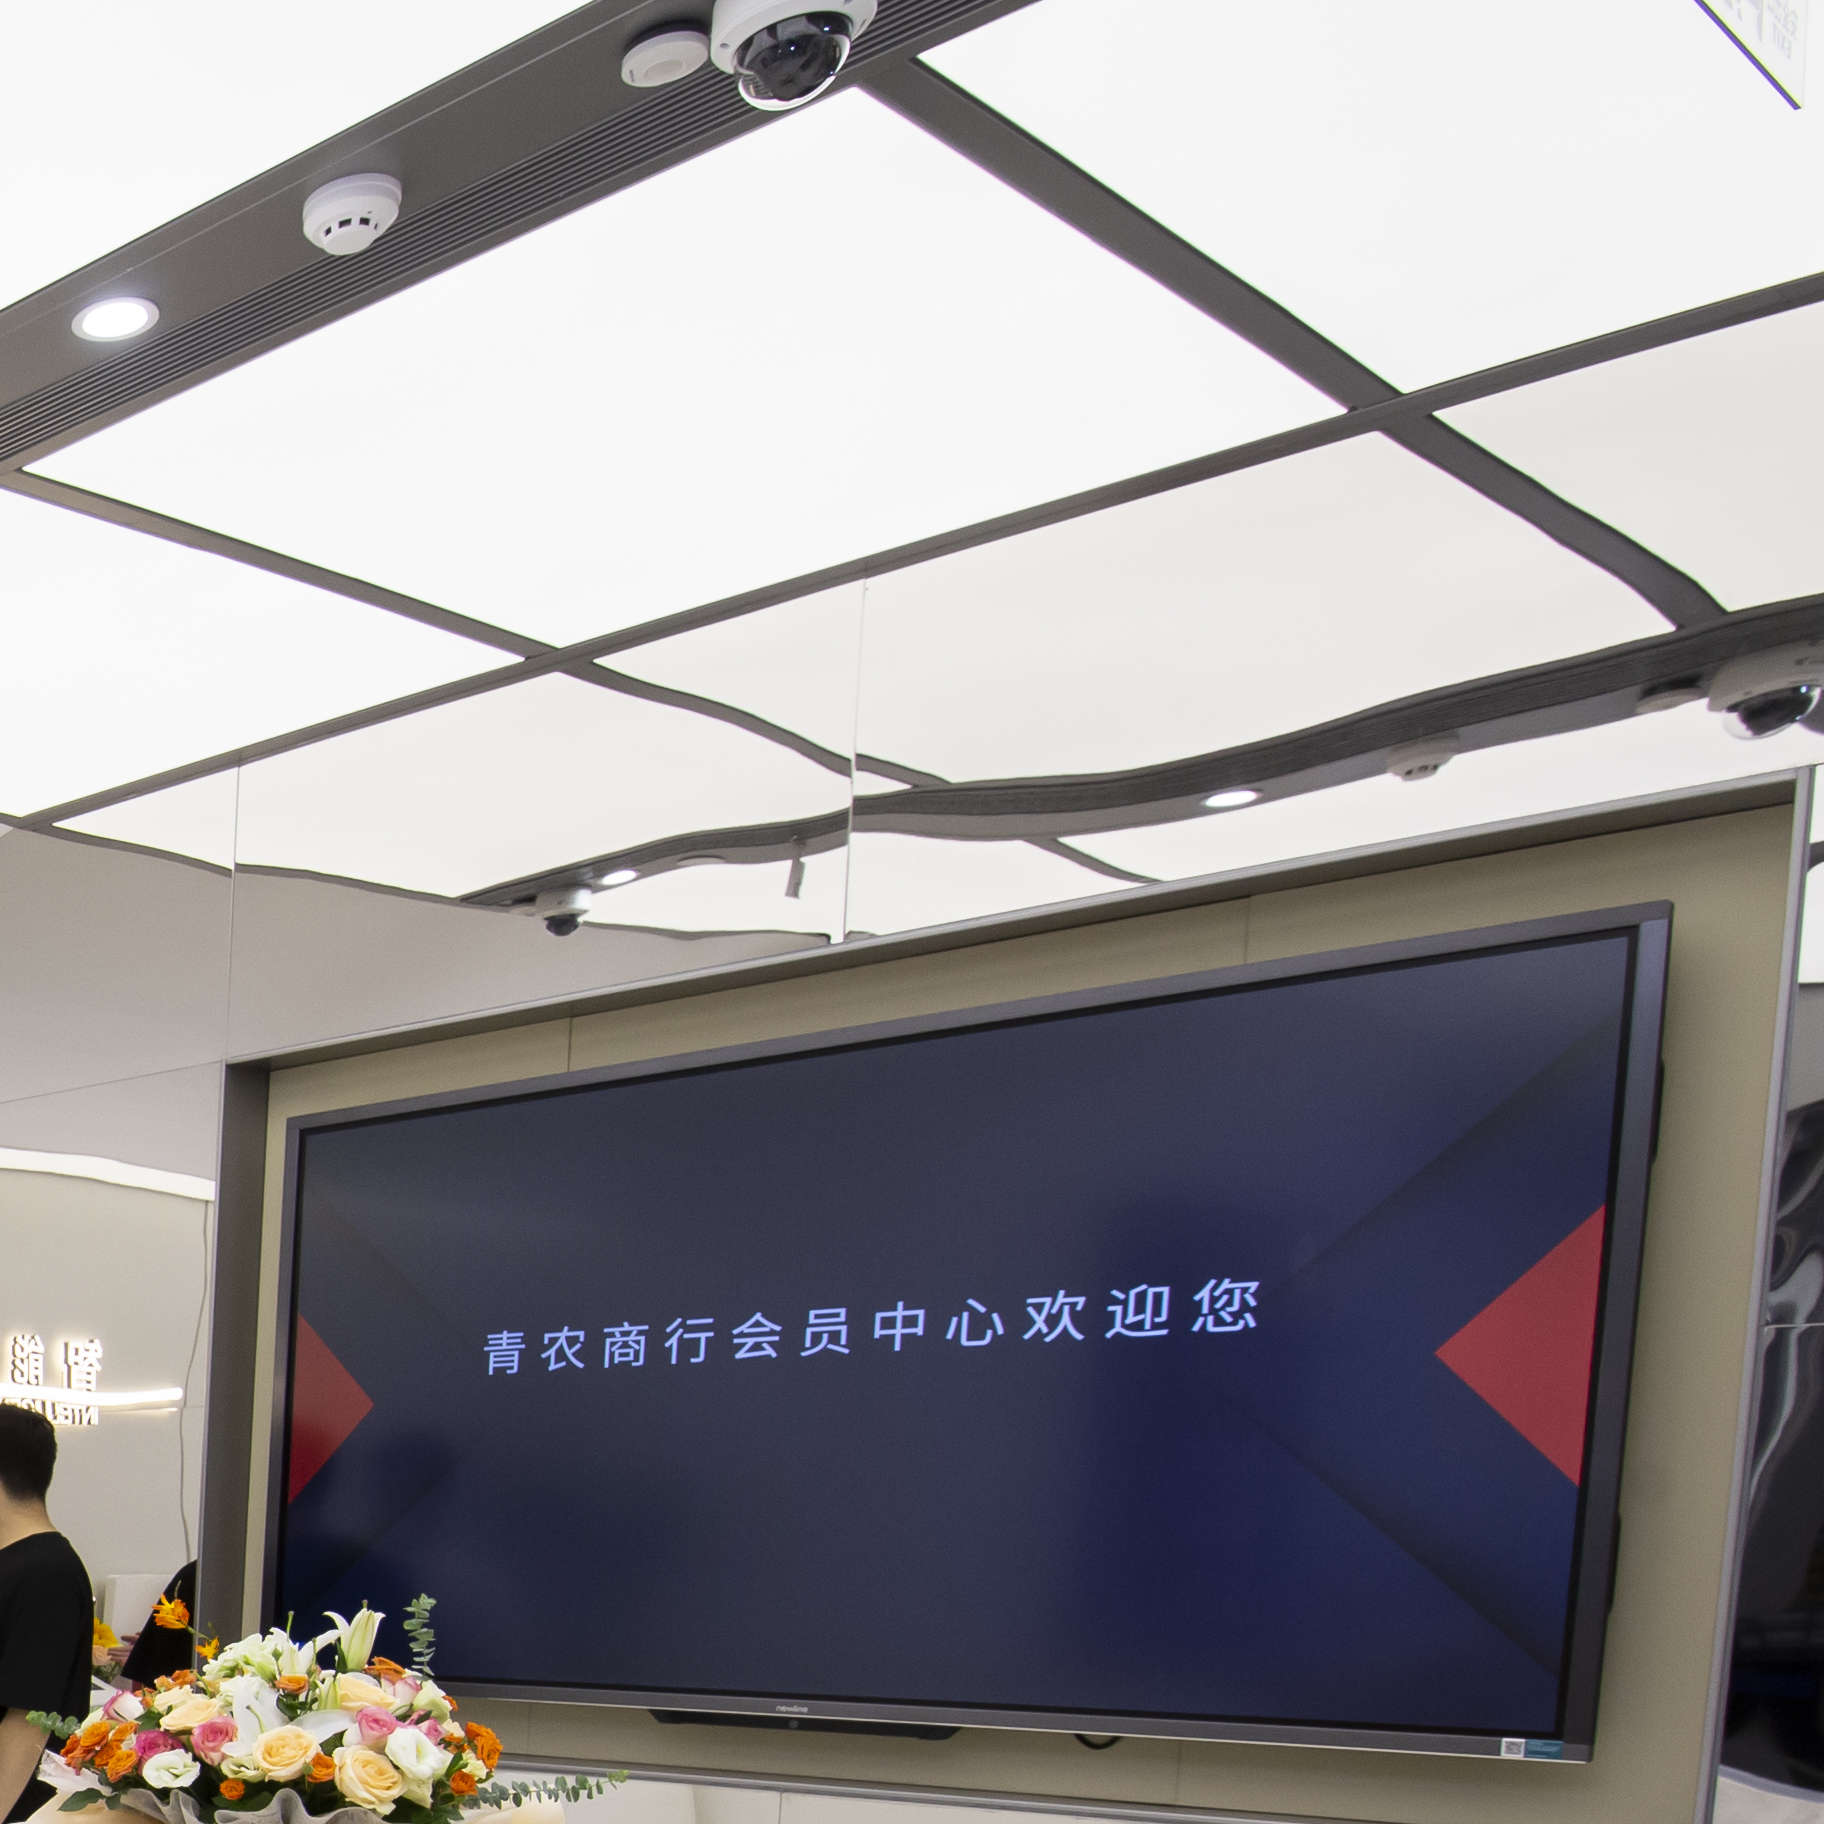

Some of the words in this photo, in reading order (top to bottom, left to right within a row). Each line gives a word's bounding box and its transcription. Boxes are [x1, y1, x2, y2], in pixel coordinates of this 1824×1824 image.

[483, 1277, 1260, 1377] 青农商行会员中心欢迎您
